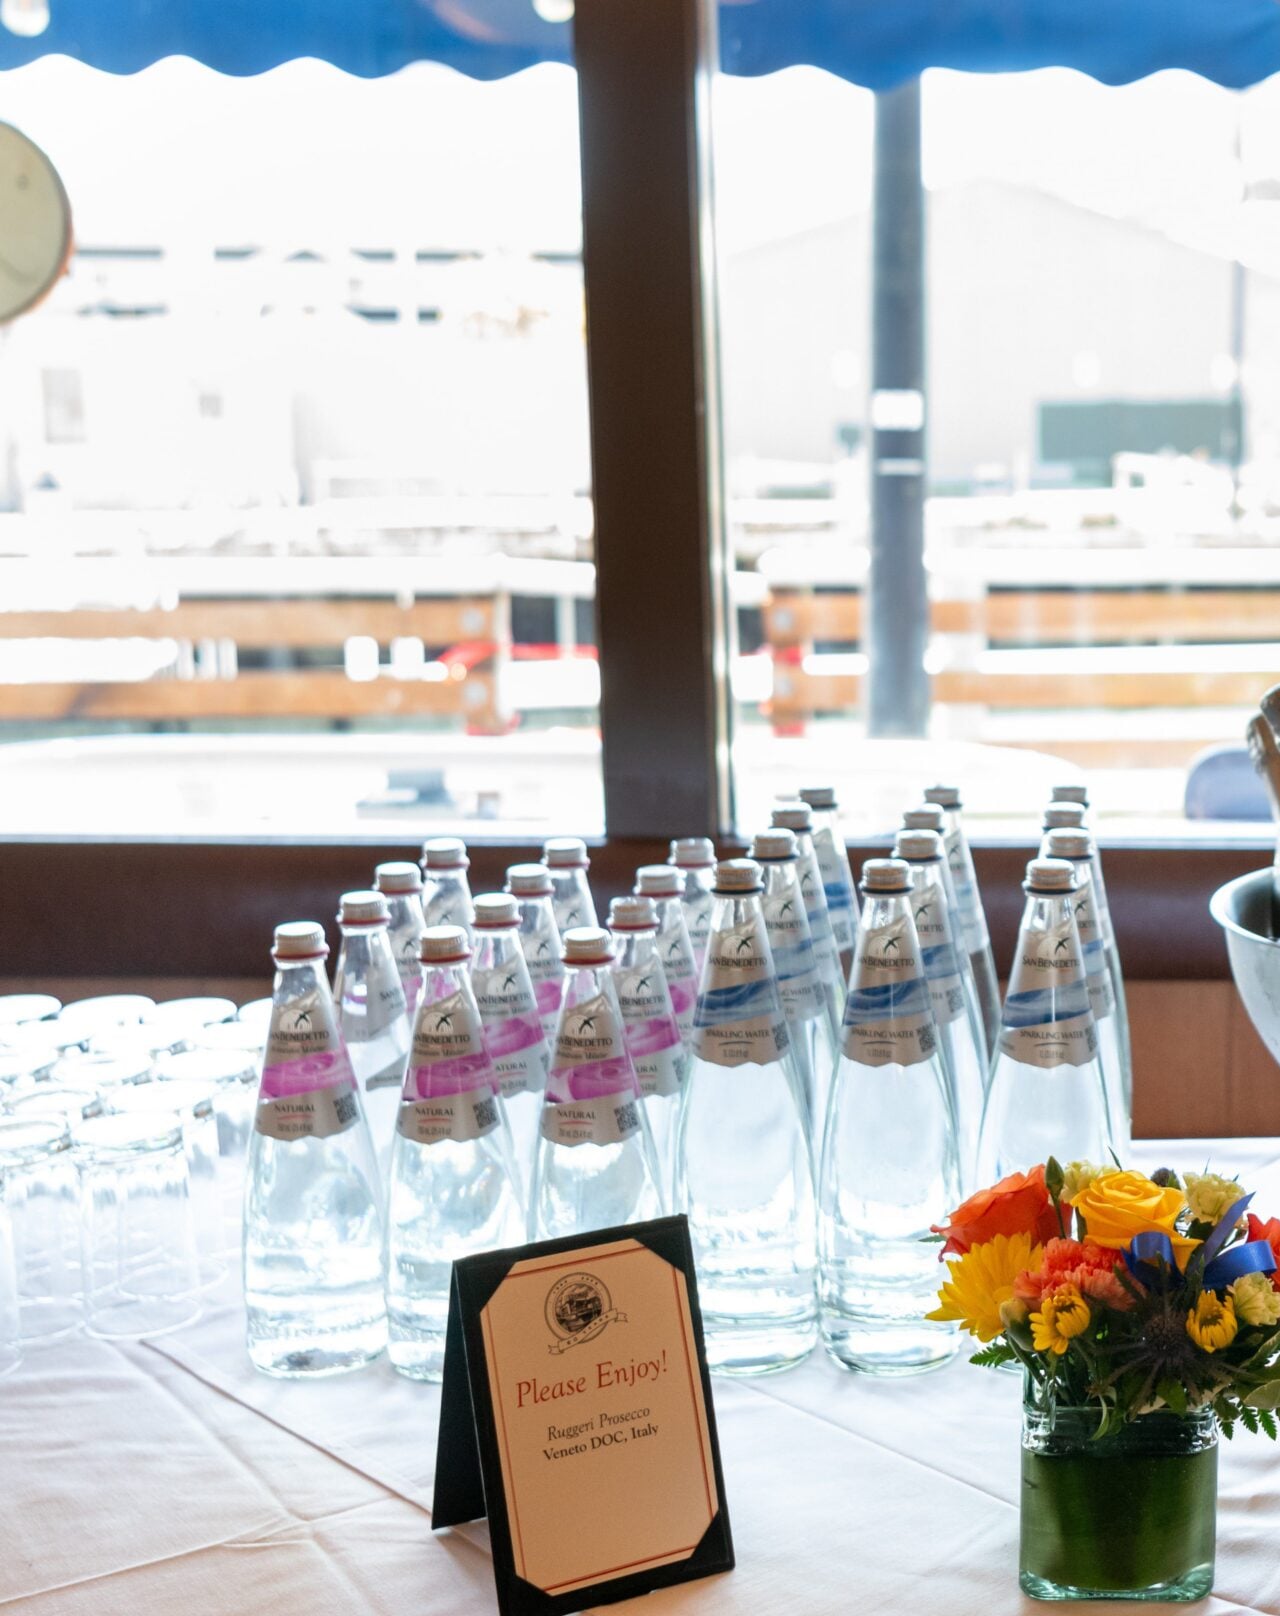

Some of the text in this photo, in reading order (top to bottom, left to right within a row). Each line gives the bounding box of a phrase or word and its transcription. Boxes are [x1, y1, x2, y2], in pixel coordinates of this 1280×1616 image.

[888, 1029, 914, 1039] WATER
[564, 1036, 612, 1047] BENEDETTO
[274, 1103, 315, 1113] NATURAL
[415, 1107, 455, 1116] NATURAL
[557, 1110, 597, 1120] NATURAL
[515, 1349, 668, 1408] Please Enjoy!
[547, 1407, 650, 1442] Ruggeri Prosecco
[542, 1423, 660, 1461] Veneto DOC, Italy
